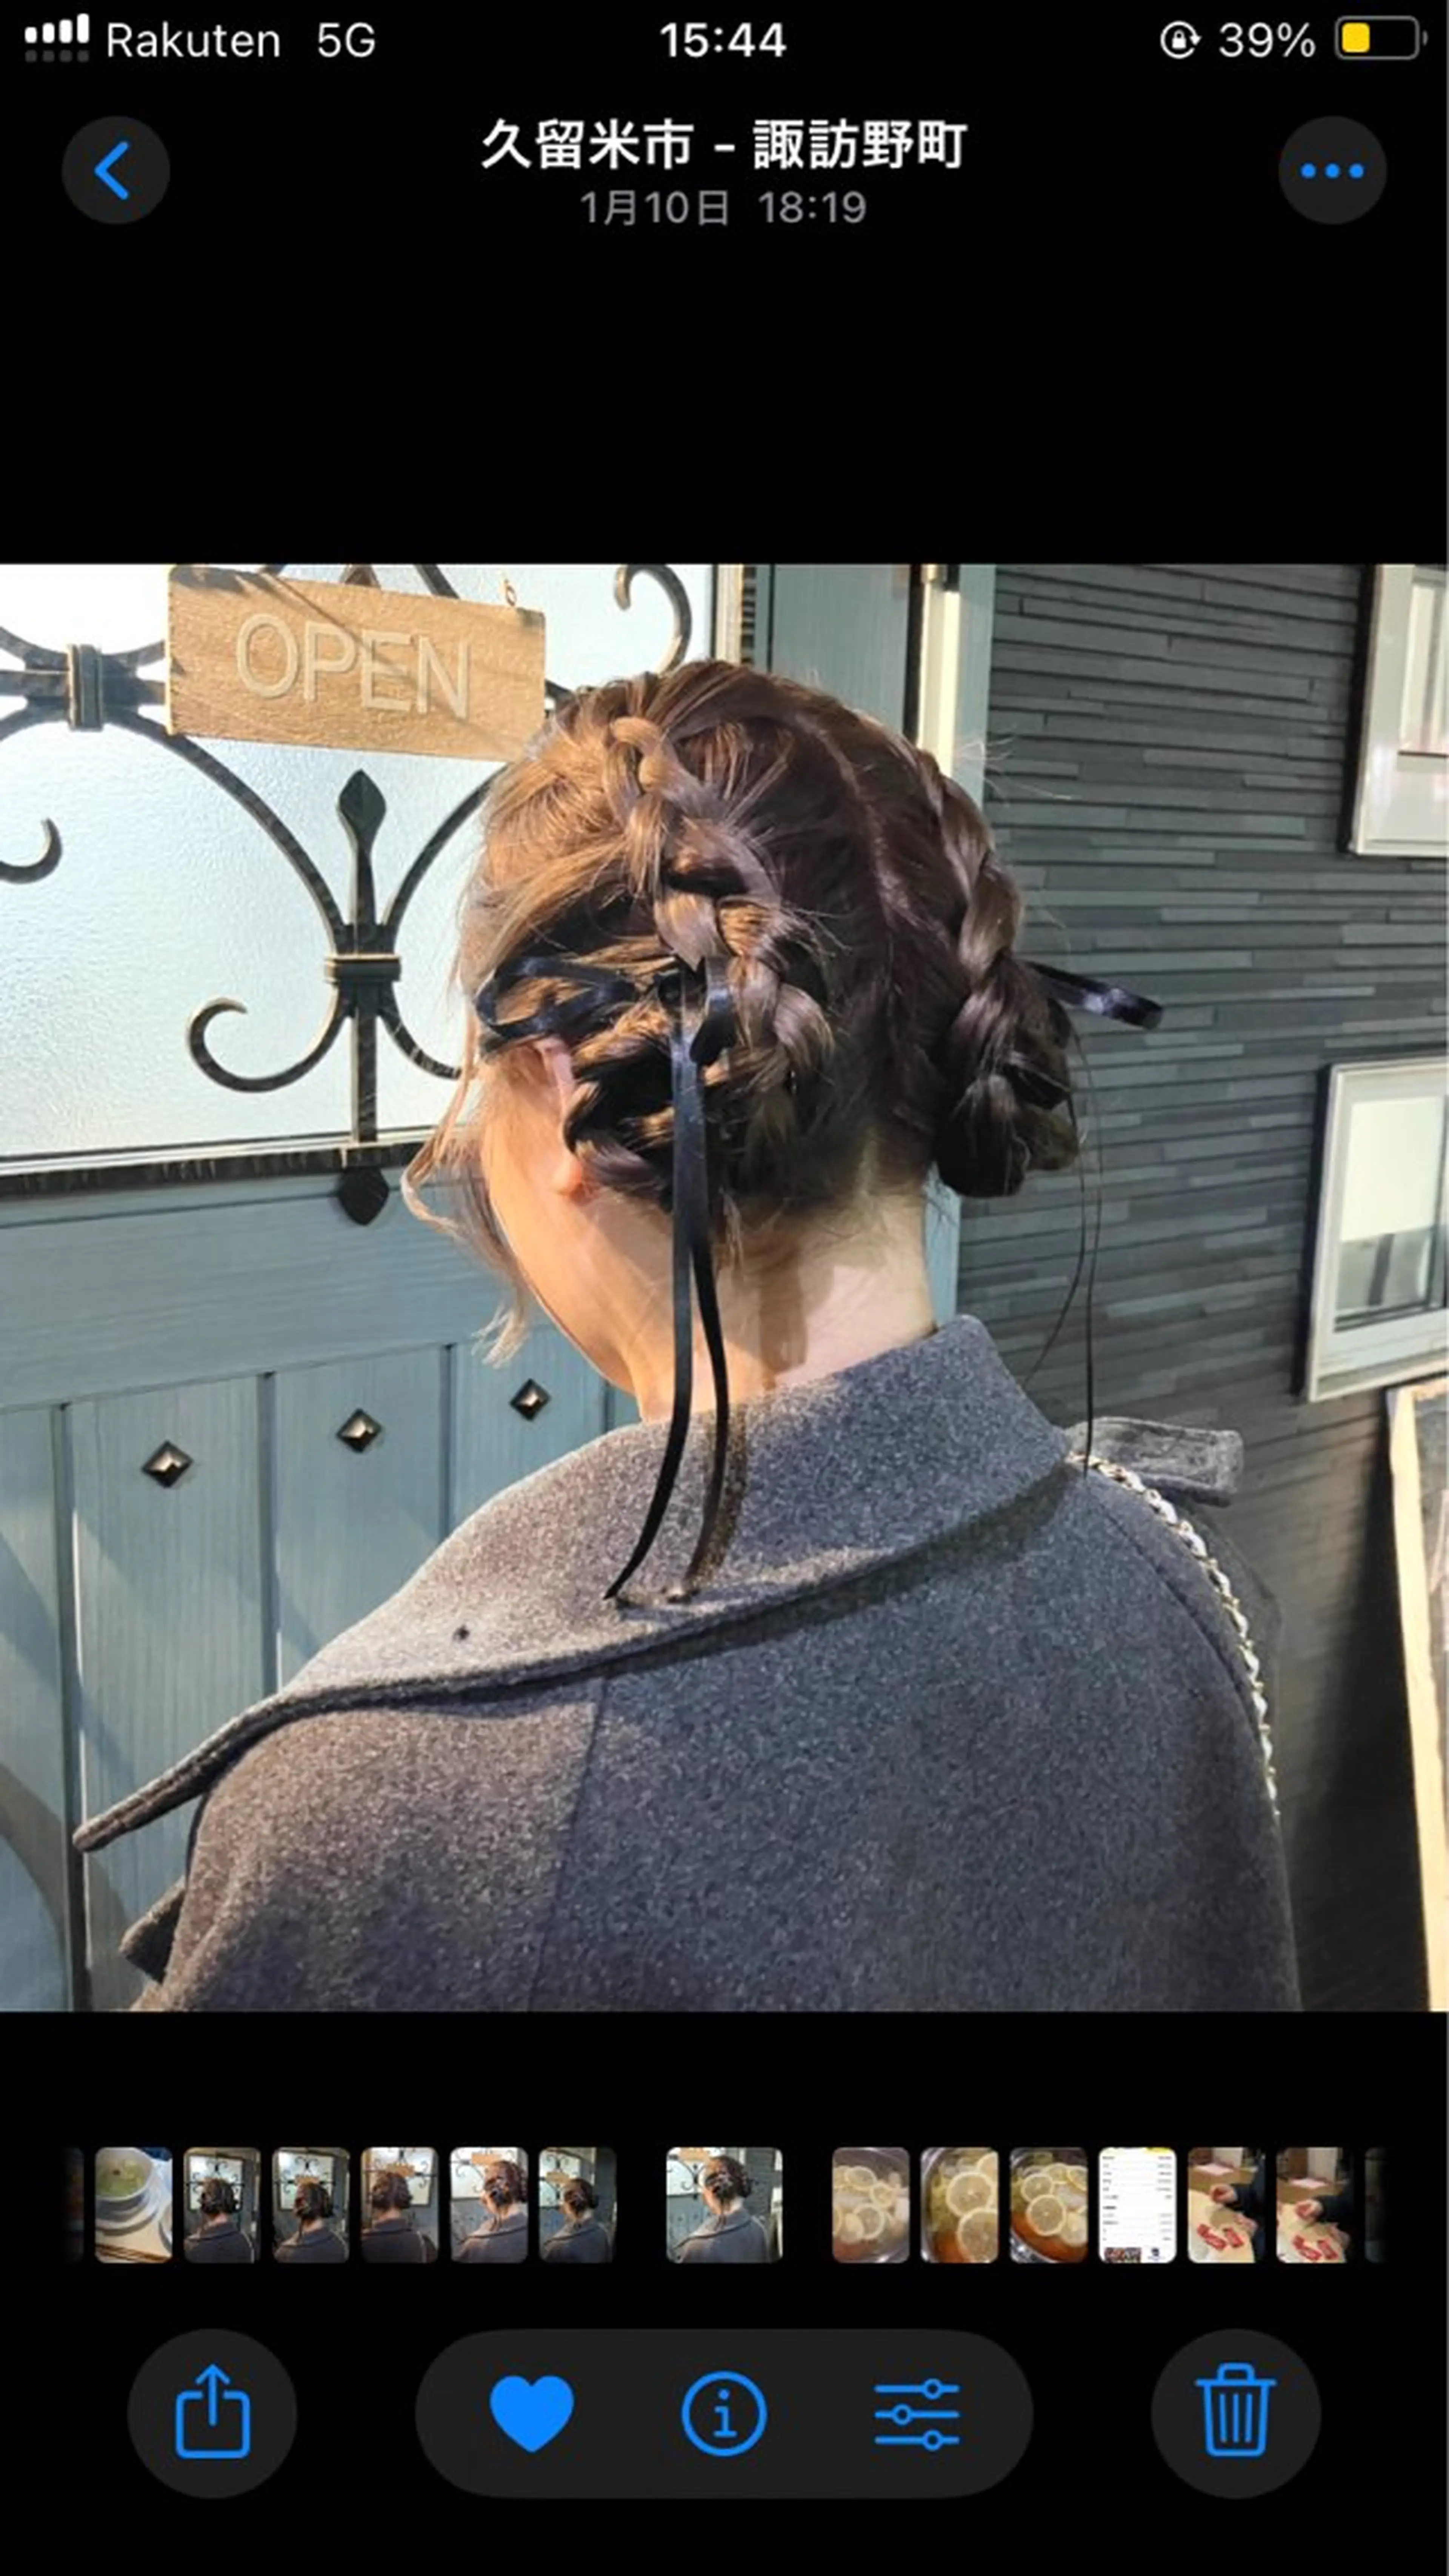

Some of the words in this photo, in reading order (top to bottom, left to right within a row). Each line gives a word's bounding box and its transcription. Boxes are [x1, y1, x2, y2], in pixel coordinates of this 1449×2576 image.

[108, 21, 280, 58] Rakuten
[318, 22, 375, 58] 5G
[660, 22, 788, 58] 15:44
[1219, 22, 1316, 58] 39%
[481, 117, 695, 170] 久留米市
[752, 117, 969, 170] 諏訪野町
[581, 190, 728, 225] 1月10日
[759, 191, 866, 223] 18:19
[236, 614, 471, 720] OPEN
